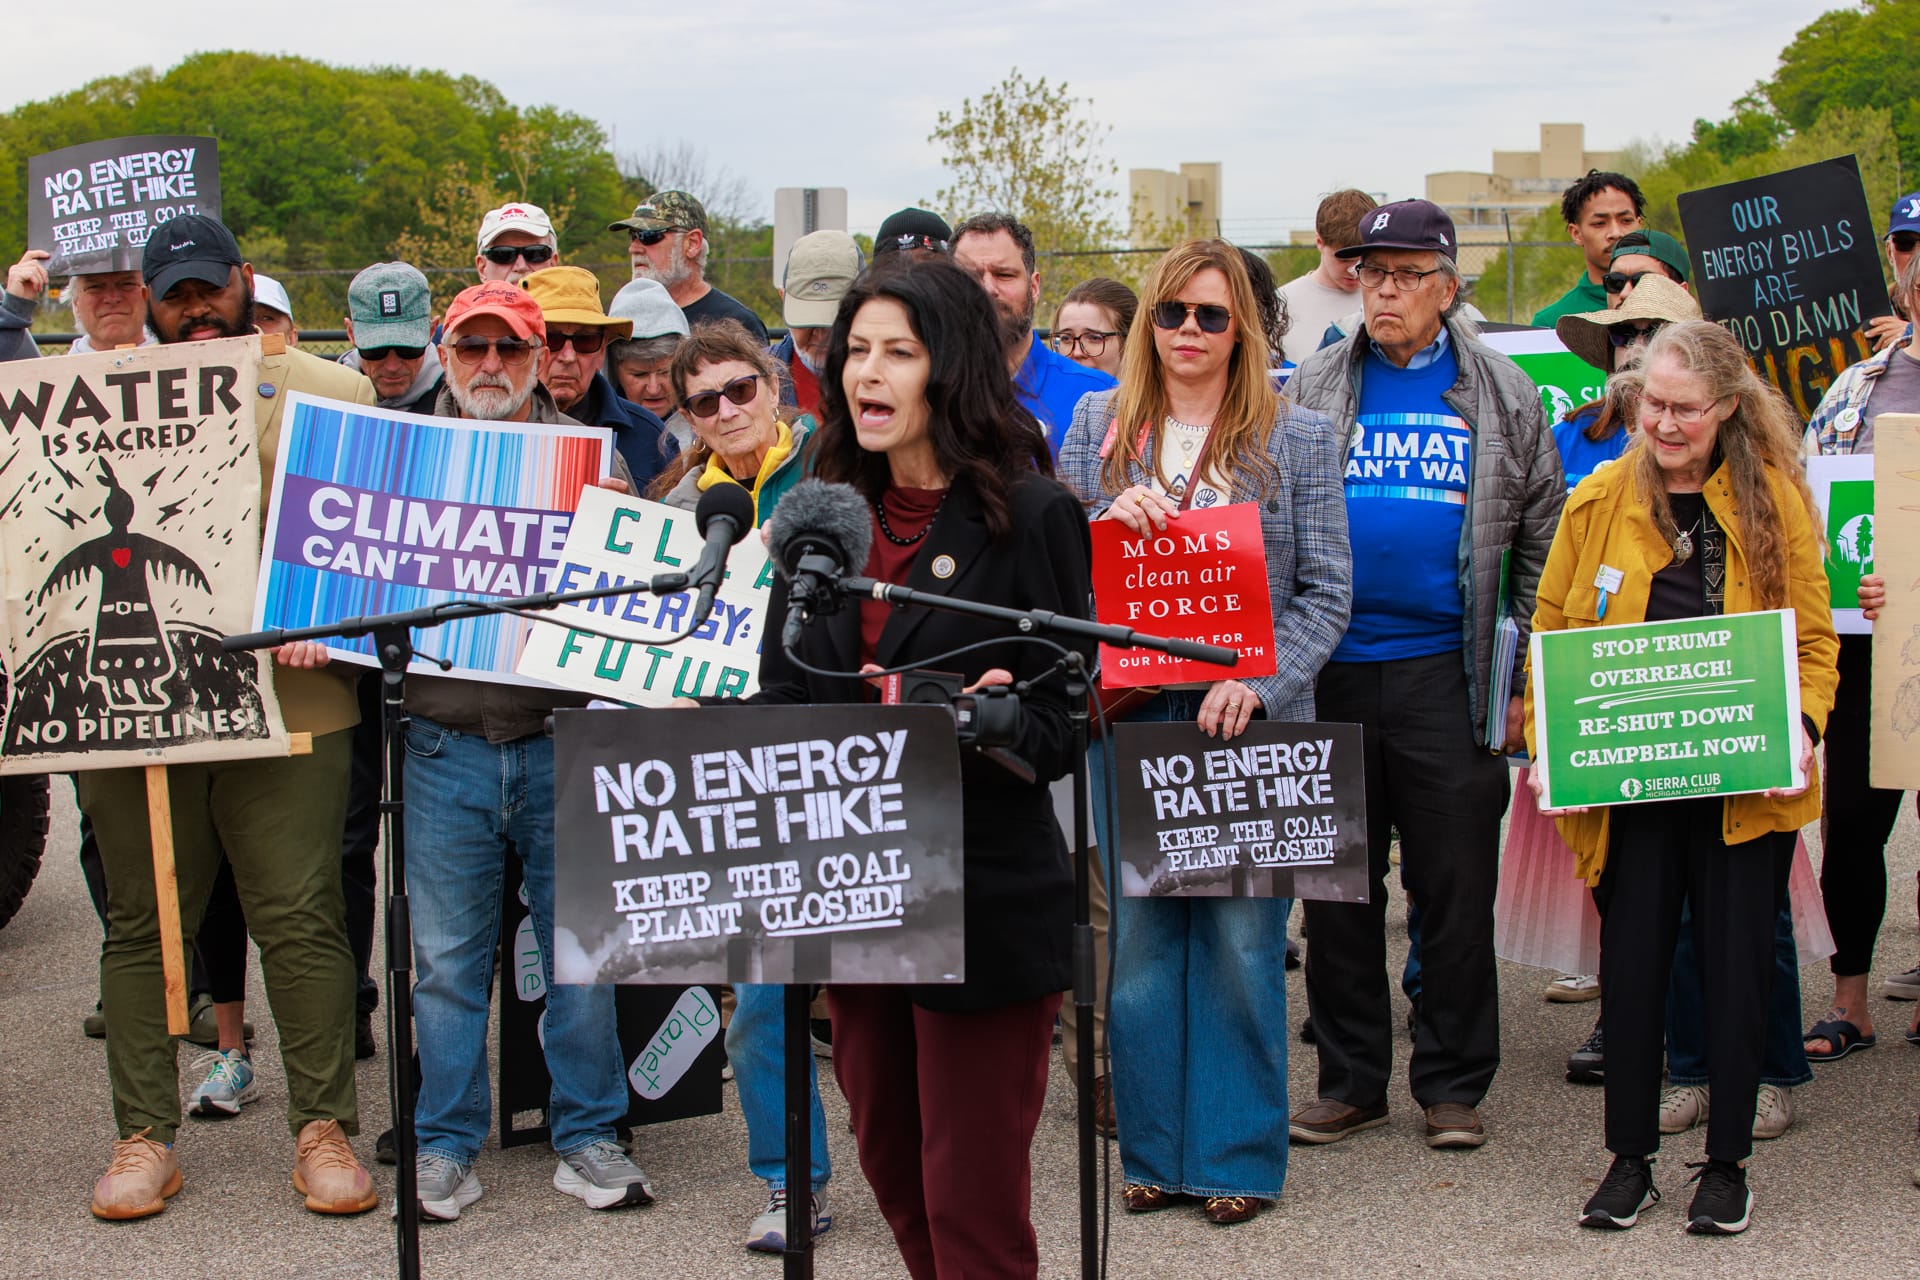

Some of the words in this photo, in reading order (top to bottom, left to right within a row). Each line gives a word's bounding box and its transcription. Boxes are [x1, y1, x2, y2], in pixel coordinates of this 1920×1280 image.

[44, 168, 83, 198] NO
[89, 148, 196, 185] ENERGY
[52, 182, 126, 219] RATE
[131, 173, 197, 202] HIKE
[52, 217, 102, 242] KEEP
[109, 209, 149, 230] THE
[1731, 196, 1782, 233] OUR
[60, 231, 119, 257] PLANT
[1702, 237, 1774, 281] ENERGY
[1781, 219, 1855, 265] BILLS
[1754, 270, 1805, 309] ARE
[1769, 289, 1861, 347] DAMN
[0, 365, 242, 435] WATER
[41, 432, 68, 457] IS
[75, 423, 196, 454] SACRED
[1353, 432, 1469, 461] LIMAT
[1344, 459, 1411, 479] AN'T
[1420, 461, 1466, 484] WA
[308, 486, 573, 561] CLIMATE
[302, 535, 440, 586] CAN'T
[1120, 529, 1232, 559] MOMS
[1125, 563, 1190, 590] clean
[1199, 560, 1237, 584] air
[1126, 593, 1242, 620] FORCE
[1212, 632, 1243, 645] FOR
[1591, 639, 1649, 659] STOP
[1651, 630, 1733, 653] TRUMP
[556, 628, 750, 698] FUTUR
[1119, 656, 1150, 668] OUR
[1589, 659, 1733, 688] OVERREACH!
[16, 720, 68, 746] NO
[1578, 710, 1675, 737] RE-SHUT
[1680, 704, 1755, 727] DOWN
[1140, 754, 1195, 789] NO
[1203, 738, 1334, 782] ENERGY
[1569, 740, 1699, 768] CAMPBELL
[1703, 734, 1767, 756] NOW!
[593, 759, 677, 813] NO
[691, 729, 909, 801] ENERGY
[1644, 775, 1688, 791] SIERRA
[1690, 772, 1721, 787] CLUB
[1153, 781, 1249, 821] RATE
[1256, 773, 1335, 809] HIKE
[1645, 789, 1681, 798] MICHIGAN
[1683, 786, 1717, 795] CHAPTER
[611, 800, 761, 863] RATE
[774, 783, 908, 844] HIKE
[1157, 825, 1220, 851] KEEP
[1229, 819, 1275, 843] THE
[1284, 815, 1338, 838] COAL
[1167, 845, 1240, 872] PLANT
[1250, 838, 1335, 865] CLOSED!
[612, 871, 711, 913] KEEP
[727, 860, 801, 899] THE
[817, 848, 911, 888] COAL
[626, 901, 742, 946] PLANT
[759, 885, 905, 932] CLOSED!
[633, 990, 716, 1092] Planet
